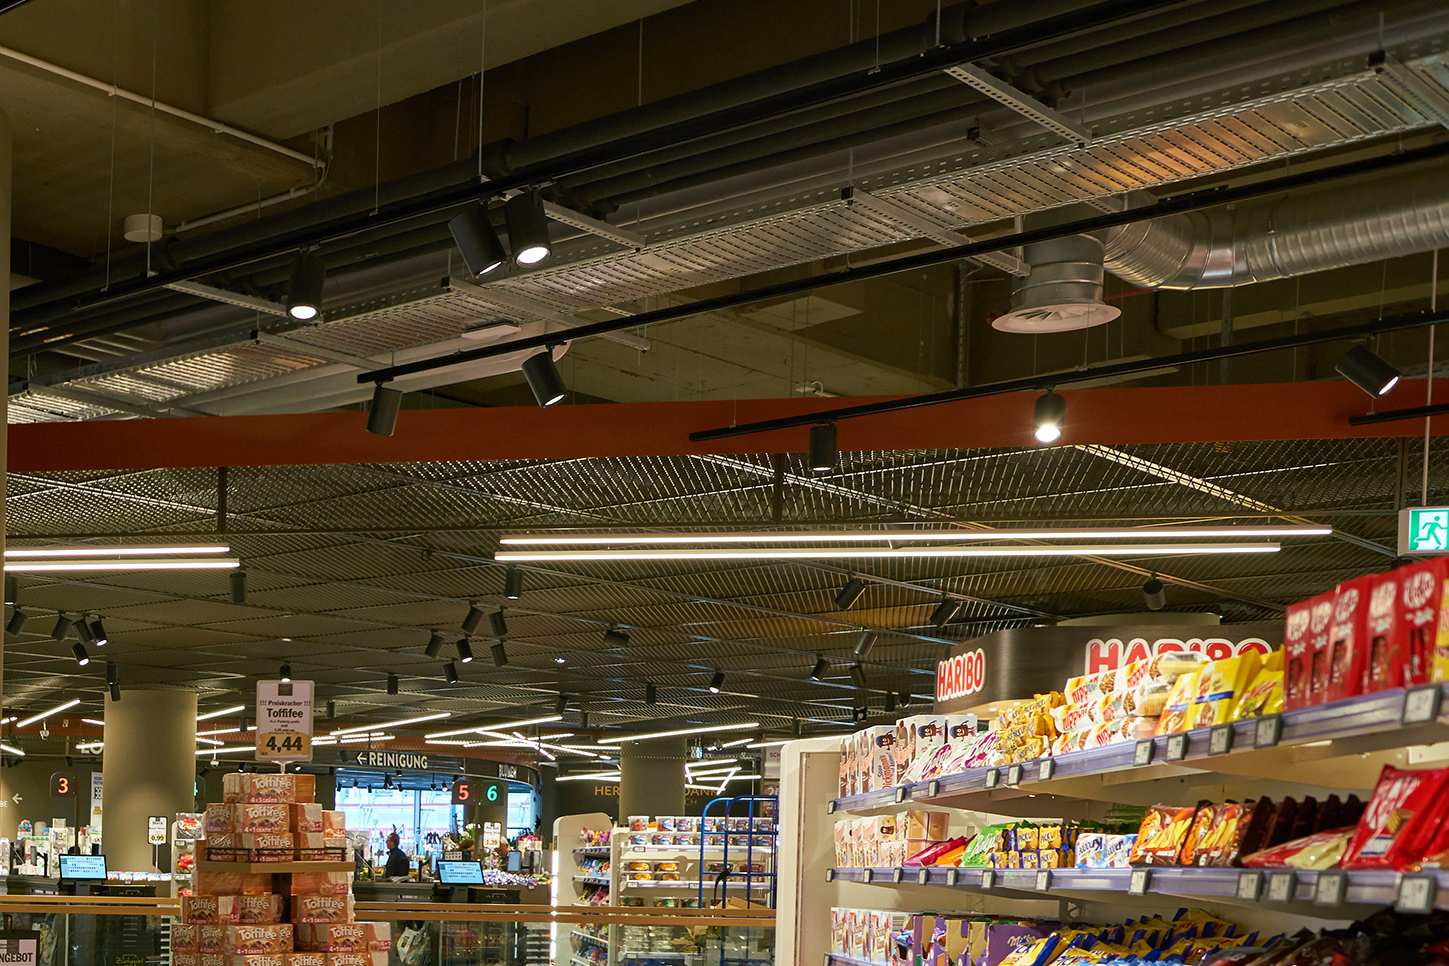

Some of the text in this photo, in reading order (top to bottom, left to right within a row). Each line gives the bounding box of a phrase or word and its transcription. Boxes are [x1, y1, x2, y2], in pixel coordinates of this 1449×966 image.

[937, 648, 986, 702] HARIBO
[266, 708, 304, 718] Toffifee
[1062, 703, 1088, 730] nippon
[266, 736, 303, 753] 4,44
[369, 751, 428, 769] REINIGUNG
[58, 777, 69, 794] 3
[252, 776, 292, 791] Toffifee
[458, 785, 470, 800] 5
[486, 785, 498, 802] 6
[246, 805, 286, 819] Toffifee
[256, 836, 290, 848] Toffifee
[303, 897, 345, 911] Toffifee
[238, 926, 277, 941] Toffifee
[330, 925, 364, 938] Toffifee
[331, 954, 365, 966] Toffifee
